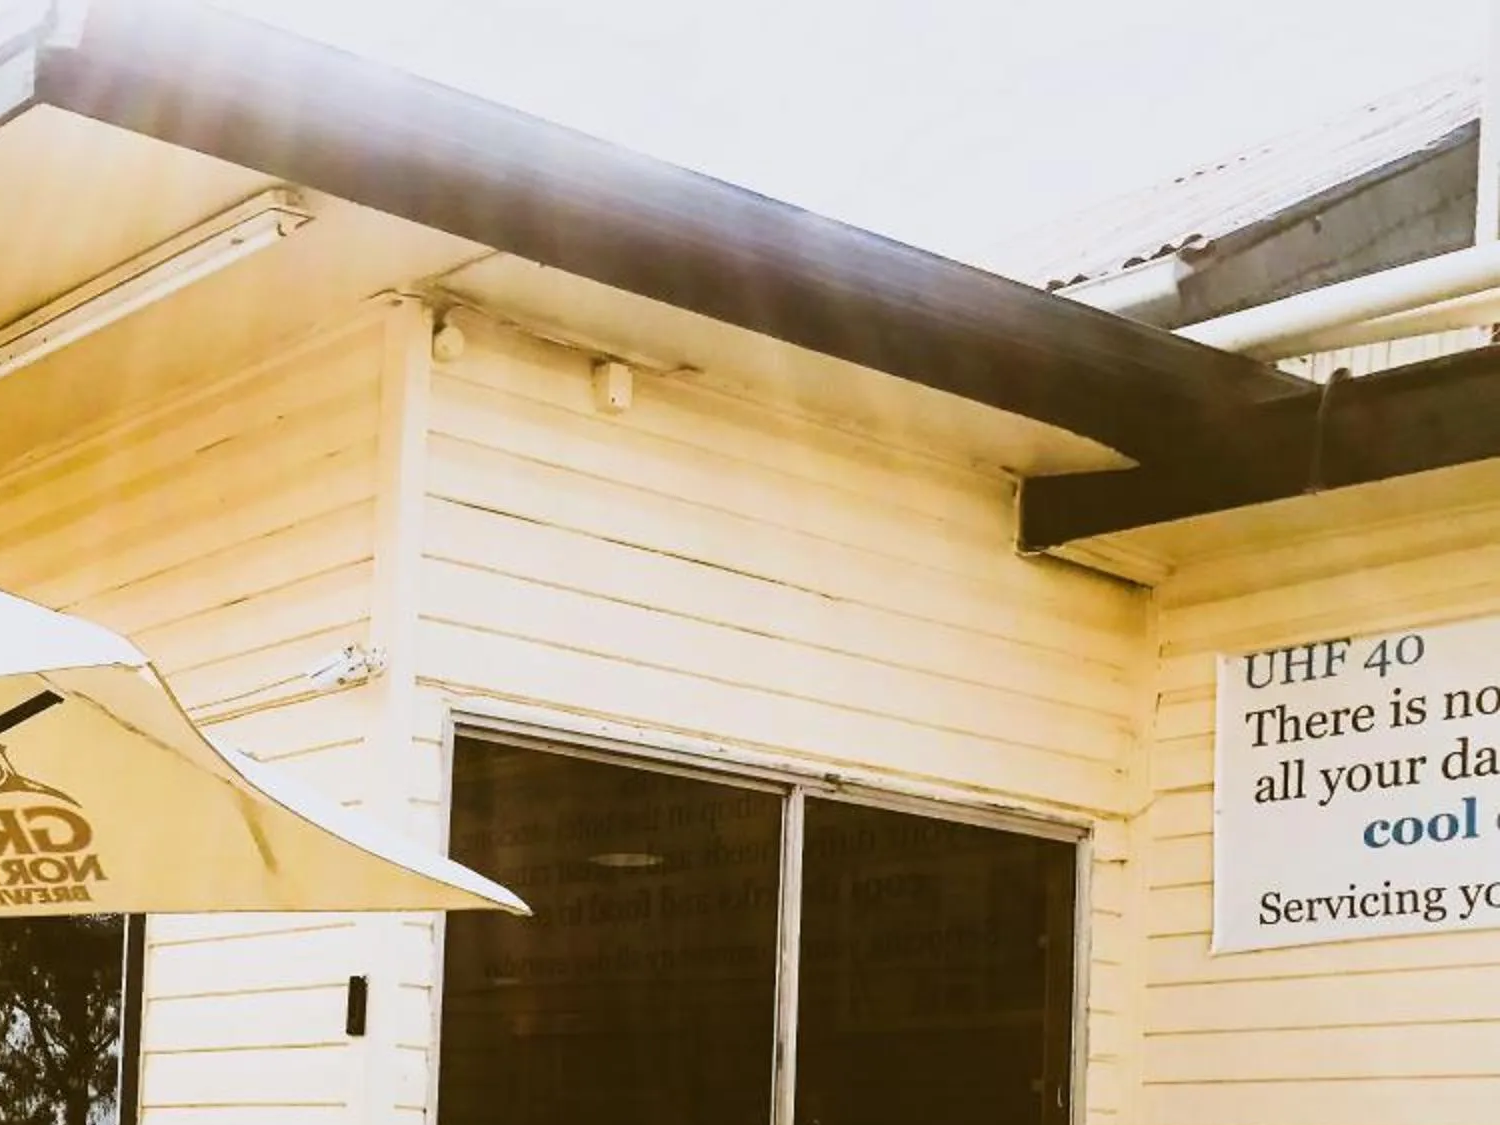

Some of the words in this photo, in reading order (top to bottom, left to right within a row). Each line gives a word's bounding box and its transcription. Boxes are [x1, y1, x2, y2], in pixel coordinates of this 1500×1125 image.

[1243, 636, 1352, 690] UHF
[1363, 634, 1426, 678] 40
[1245, 701, 1376, 748] There
[1390, 687, 1428, 729] is
[1443, 683, 1500, 721] no
[1254, 759, 1307, 805] all
[1318, 755, 1428, 807] your
[1442, 737, 1500, 781] da
[1363, 796, 1480, 849] cool
[1259, 880, 1448, 926] Servicing
[1458, 880, 1500, 919] yo
